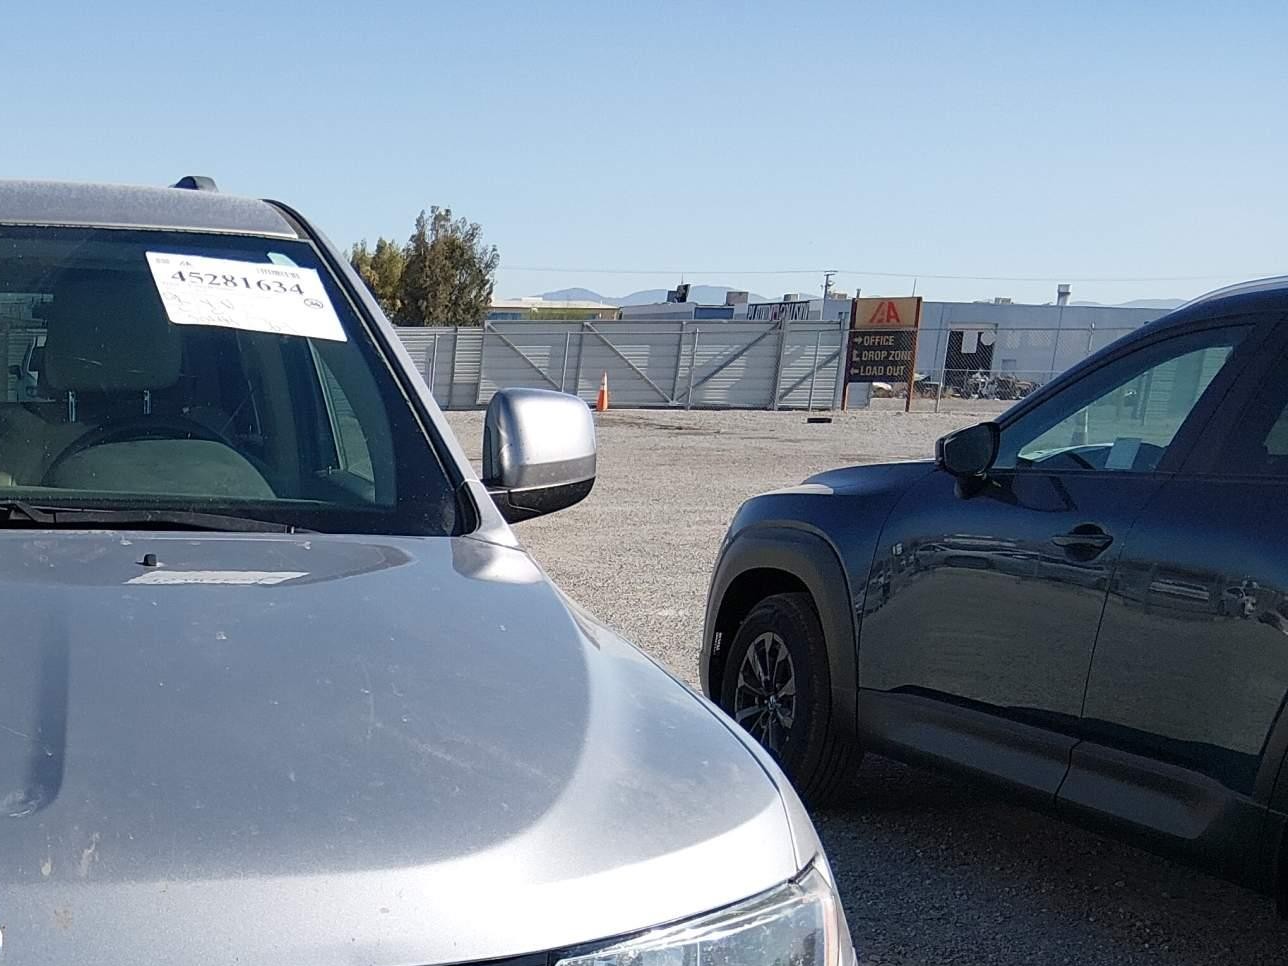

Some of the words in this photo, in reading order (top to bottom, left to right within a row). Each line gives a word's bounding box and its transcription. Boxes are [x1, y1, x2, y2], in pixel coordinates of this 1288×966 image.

[170, 270, 304, 296] 45281634
[863, 335, 895, 346] OFFICE
[862, 350, 888, 361] DROP
[860, 366, 884, 376] LOAD
[886, 366, 906, 376] OUT
